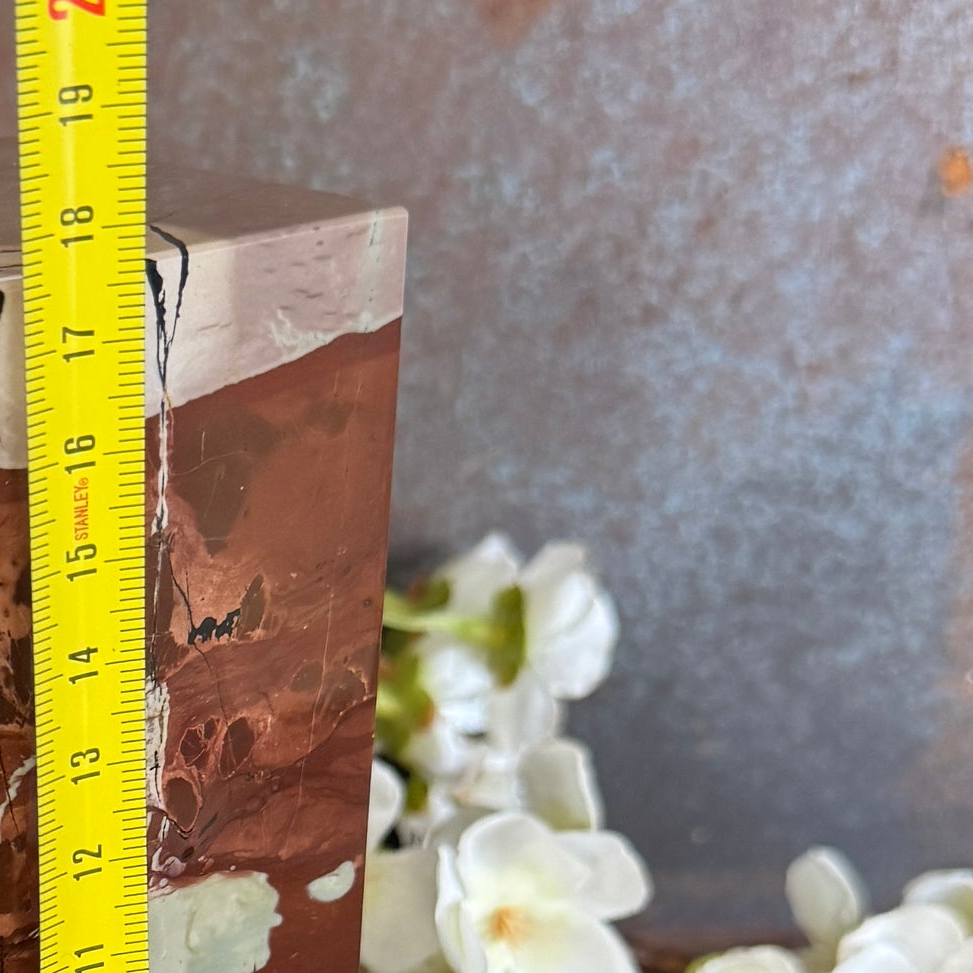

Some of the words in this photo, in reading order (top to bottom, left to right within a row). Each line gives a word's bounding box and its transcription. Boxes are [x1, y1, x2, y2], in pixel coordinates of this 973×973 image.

[58, 84, 93, 127] 19
[60, 205, 94, 248] 18
[62, 326, 95, 363] 17
[64, 434, 96, 475] 16
[66, 543, 97, 582] 15
[68, 647, 99, 685] 14
[70, 747, 100, 785] 13
[72, 844, 102, 881] 12
